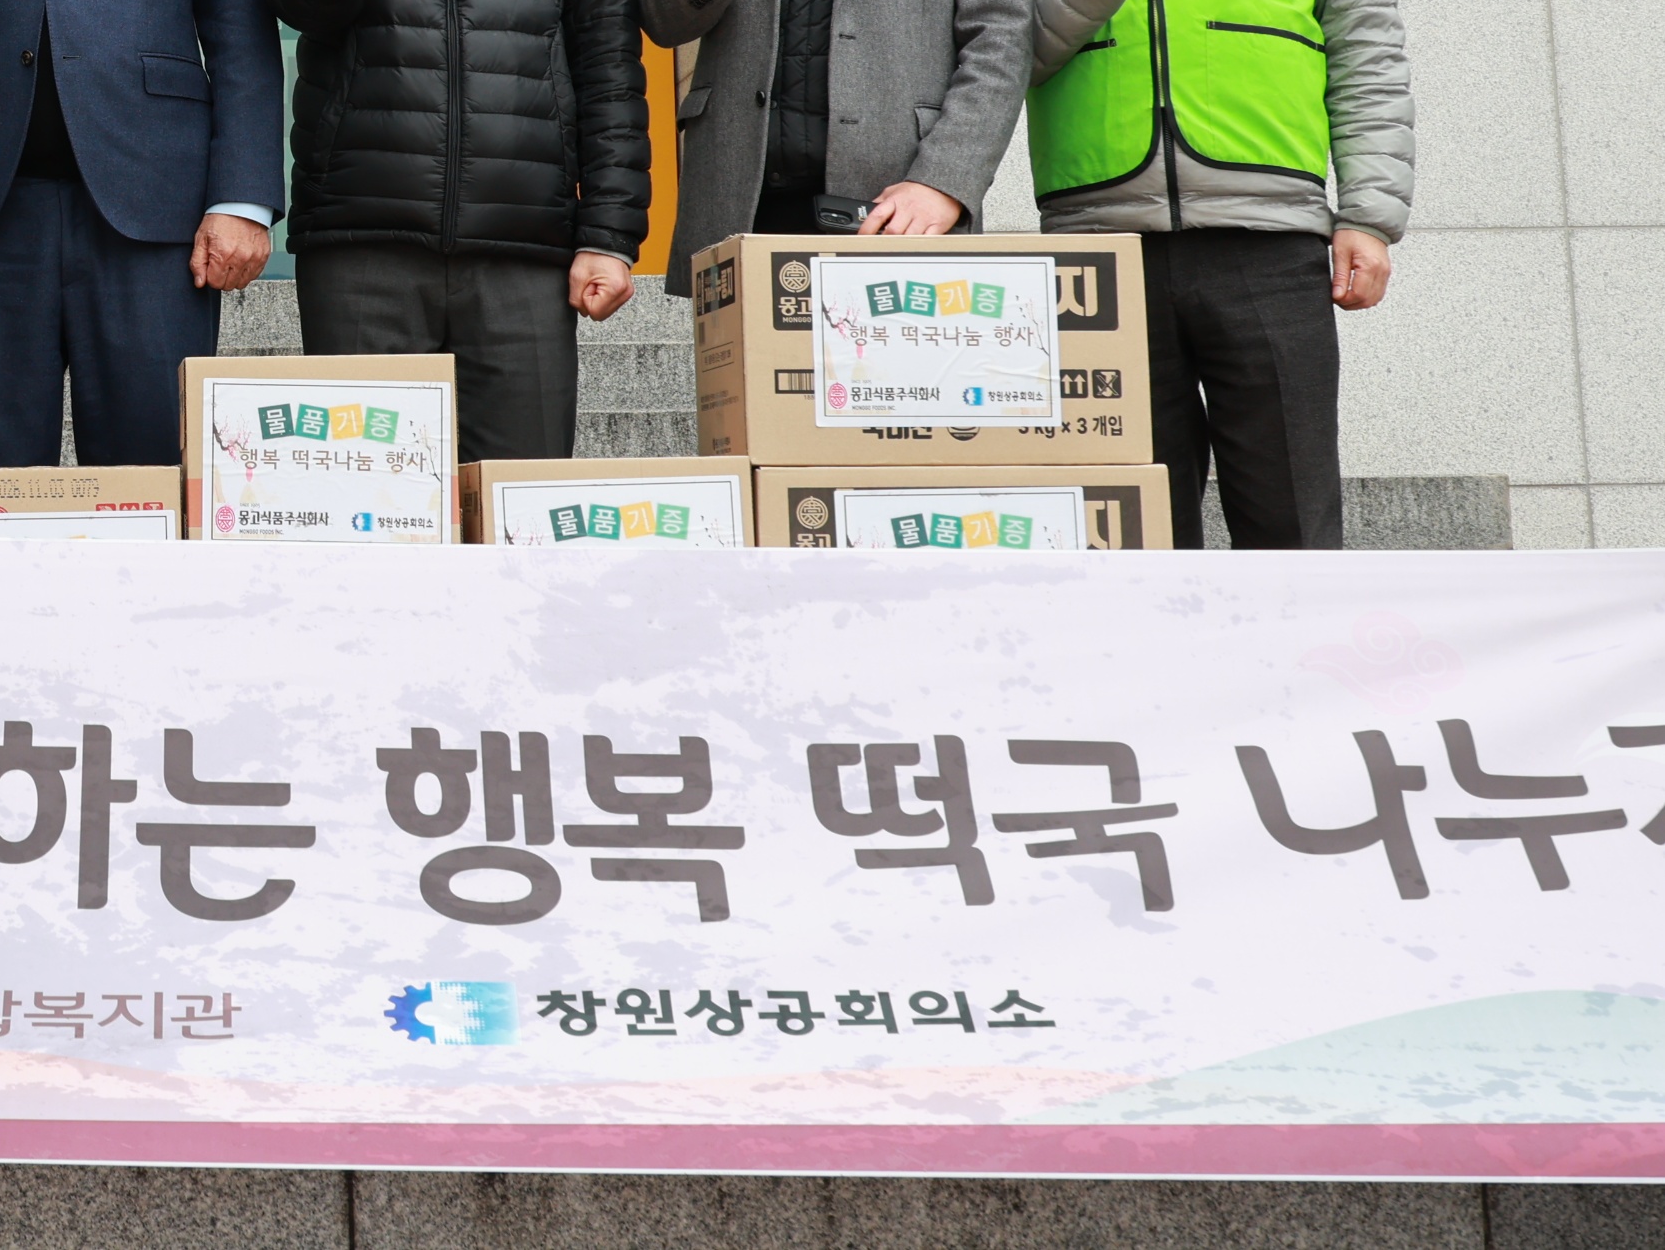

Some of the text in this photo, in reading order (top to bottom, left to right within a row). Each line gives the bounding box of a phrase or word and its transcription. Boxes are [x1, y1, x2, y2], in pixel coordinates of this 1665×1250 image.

[778, 296, 813, 317] 몽고
[872, 284, 1001, 315] 물품기증
[849, 325, 1034, 347] 행복 떡국나눔 행사
[850, 386, 940, 403] 몽고식품주식회사
[987, 389, 1044, 402] 창원상공회의소
[264, 407, 392, 440] 물품기증
[1077, 417, 1088, 434] 3
[1092, 415, 1124, 436] 개입
[239, 448, 427, 473] 행복 떡국나눔 행사
[238, 510, 330, 527] 몽고식품주식회사
[377, 516, 434, 528] 창원상공회의소
[555, 505, 686, 539] 물품기증
[897, 516, 1028, 546] 물품기증
[375, 726, 746, 926] 행복
[806, 734, 1179, 913] 떡국
[535, 988, 1057, 1039] 창원상공회의소
